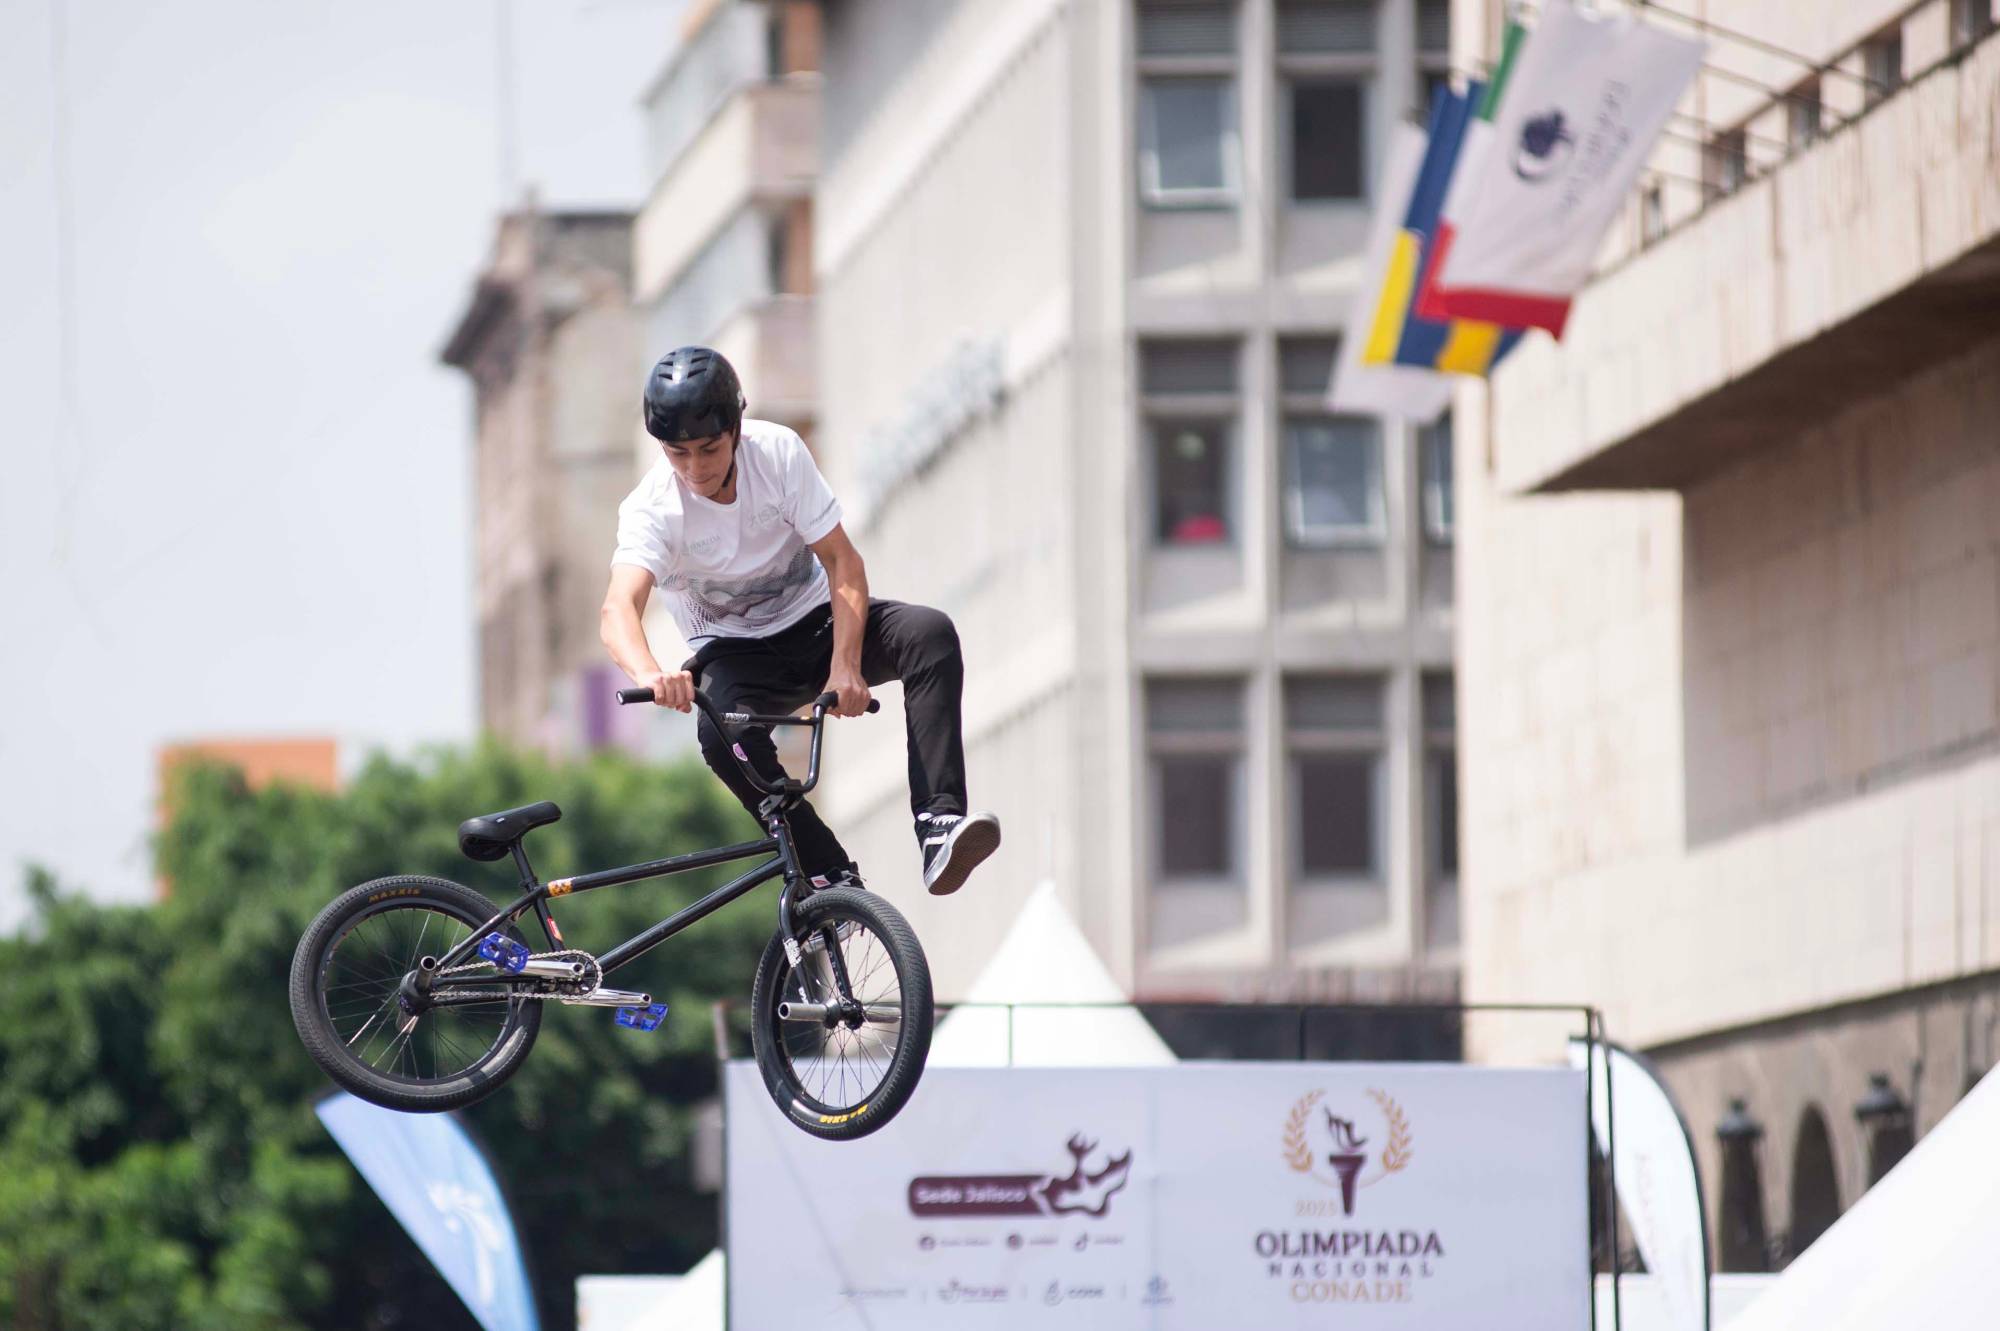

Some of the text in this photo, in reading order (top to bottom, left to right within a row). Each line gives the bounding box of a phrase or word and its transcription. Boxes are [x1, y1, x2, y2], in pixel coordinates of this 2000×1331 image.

[964, 1184, 1026, 1202] Jalisco
[1255, 1231, 1444, 1258] OLIMPIADA
[1269, 1261, 1434, 1278] NACIONAL
[1291, 1280, 1412, 1302] CONADE
